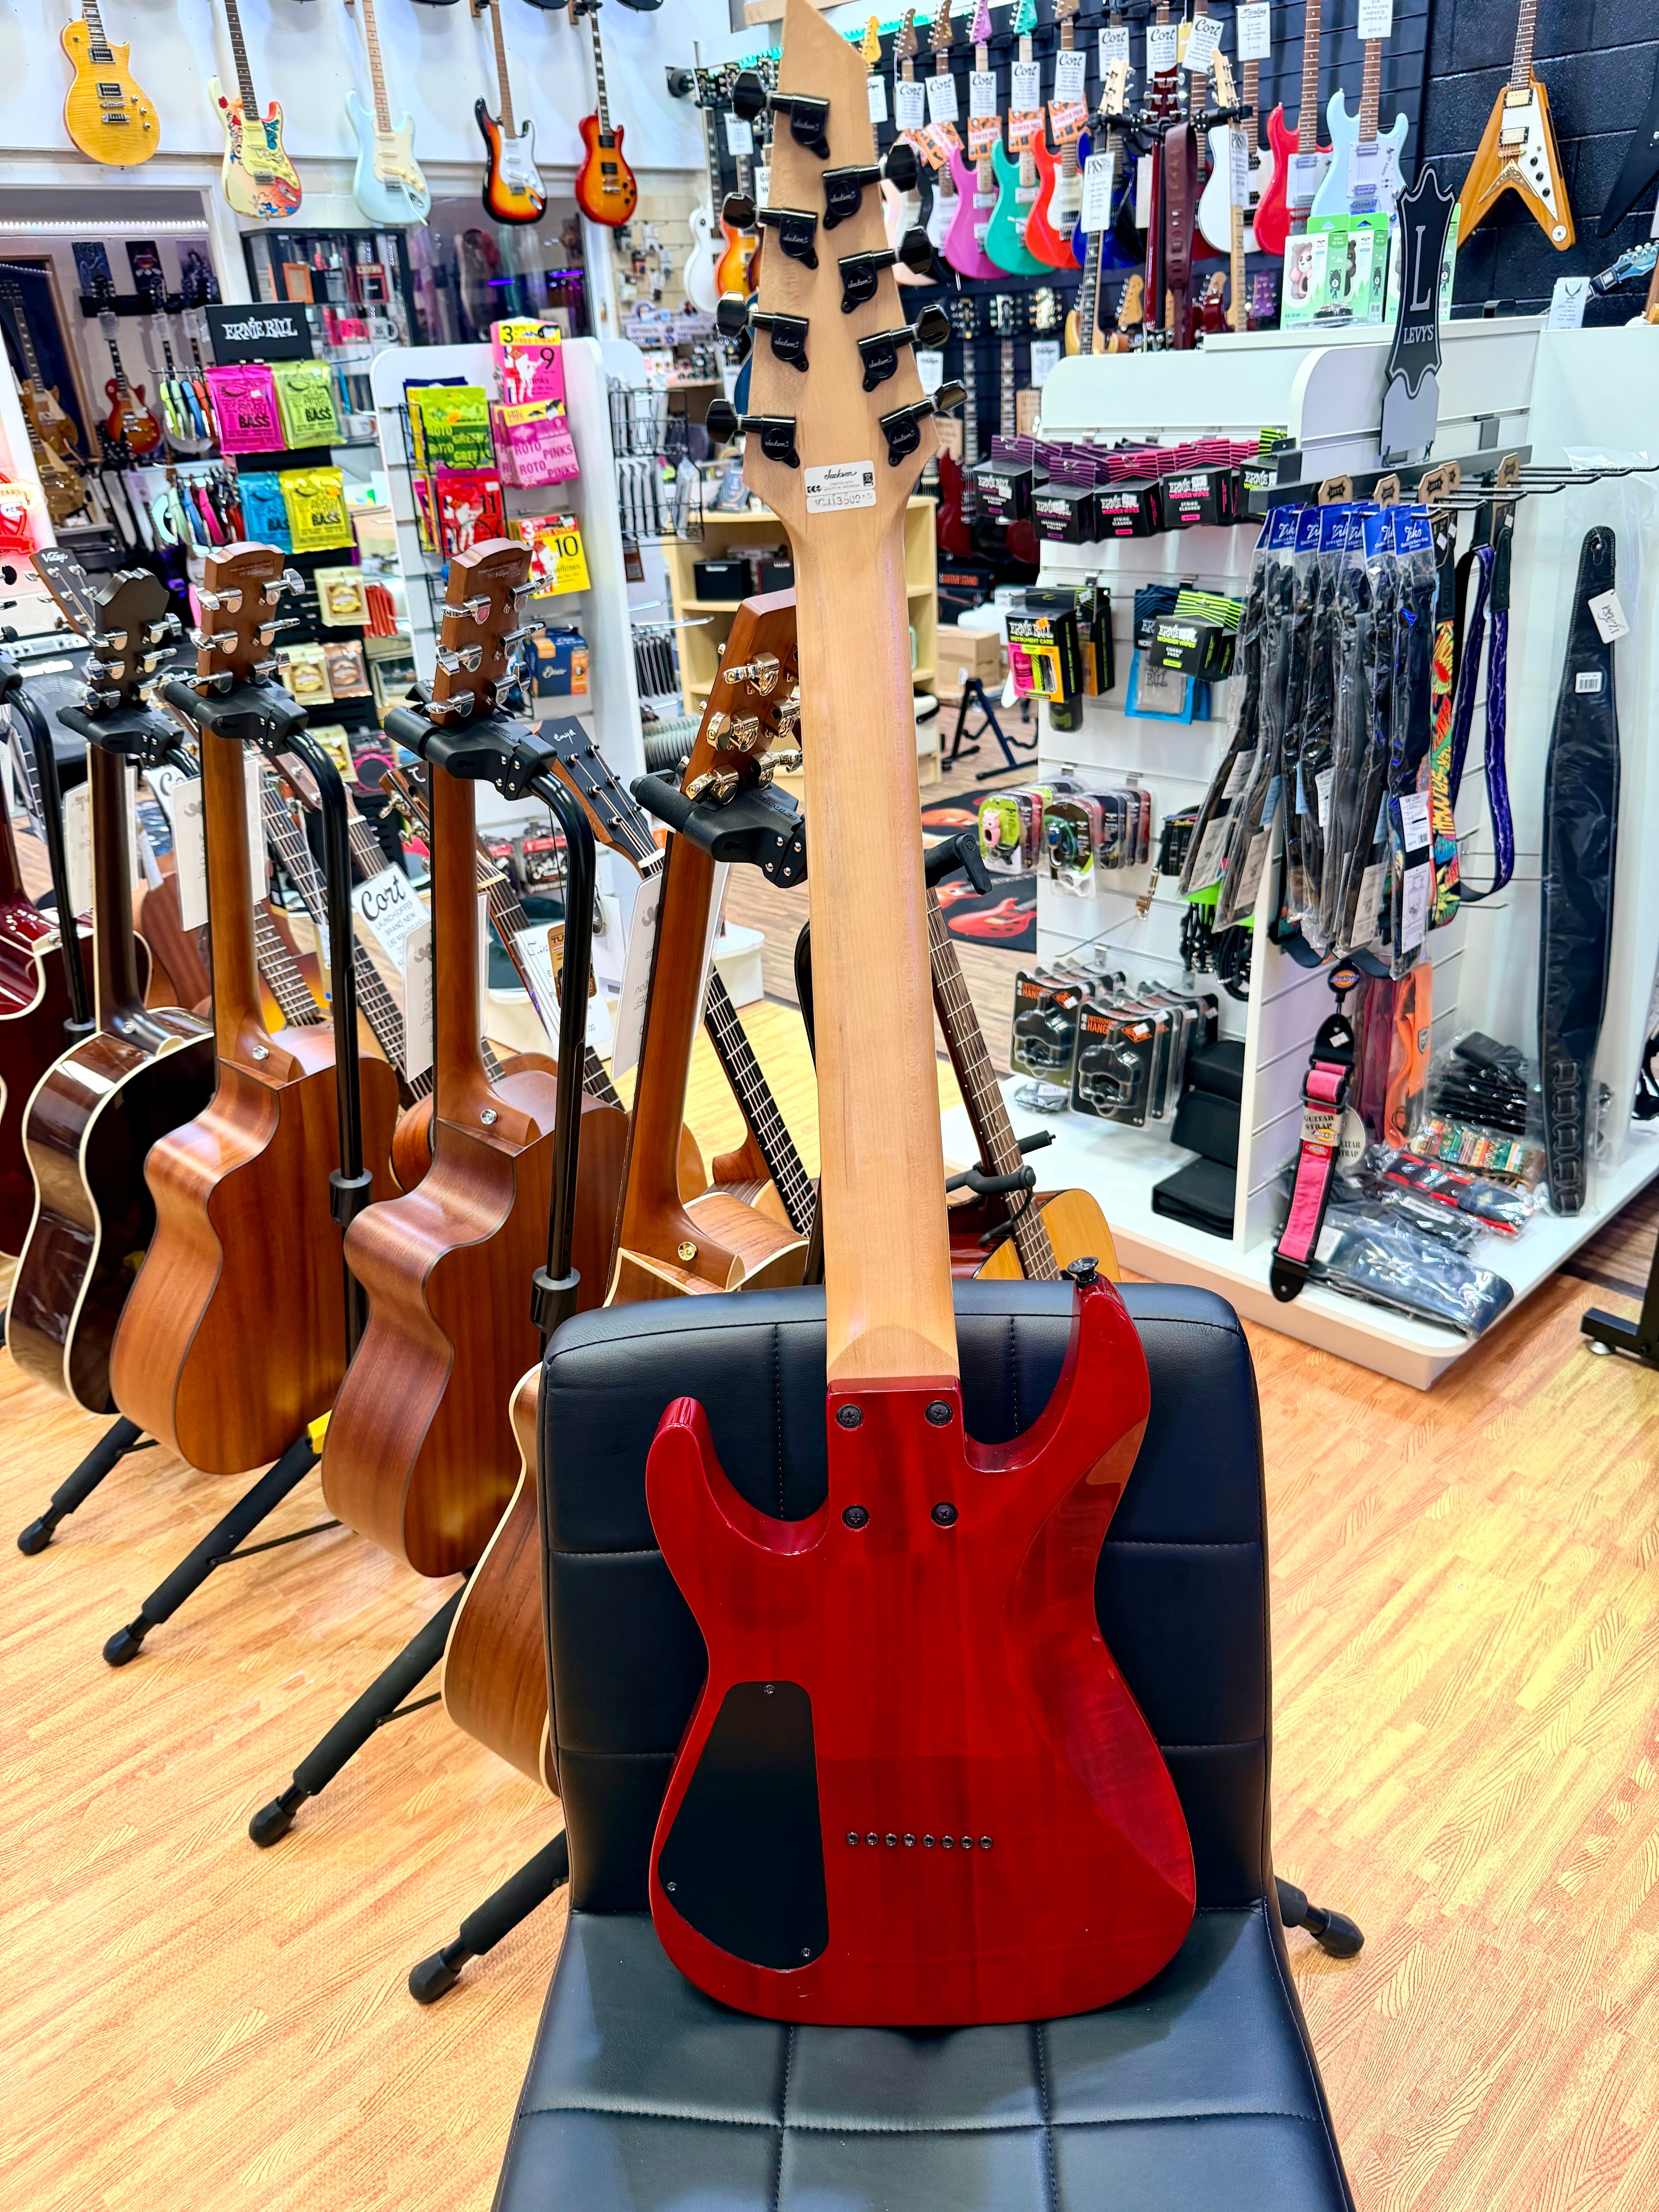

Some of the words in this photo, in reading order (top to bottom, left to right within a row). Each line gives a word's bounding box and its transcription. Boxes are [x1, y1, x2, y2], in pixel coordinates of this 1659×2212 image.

[1151, 28, 1175, 42] Cort
[1195, 19, 1221, 36] Cort
[1102, 29, 1126, 44] Cort
[1059, 53, 1083, 66] Cort
[1014, 64, 1037, 76] Cort
[930, 79, 952, 91] Cort
[972, 73, 994, 86] Cort
[900, 84, 922, 96] Cort
[831, 192, 855, 203] Jackson
[783, 234, 808, 244] Jackson
[1410, 225, 1431, 311] L
[848, 277, 872, 289] Jackson
[221, 317, 264, 340] ERNIE
[264, 318, 298, 338] BALL
[502, 325, 513, 343] 3
[1403, 324, 1434, 345] LEVY'S
[775, 338, 799, 348] Jackson
[540, 347, 554, 369] 9
[869, 357, 893, 368] Jackson
[238, 414, 270, 428] BASS
[305, 408, 332, 421] BASS
[892, 431, 915, 444] Jackson
[515, 441, 541, 456] ROTO
[543, 444, 574, 459] PINKS
[519, 461, 546, 476] ROTO
[547, 464, 579, 478] PINKS
[824, 457, 857, 479] Jackson
[1244, 470, 1269, 484] ERNIE
[1168, 477, 1191, 493] ERNIE
[480, 493, 496, 514] 11
[1100, 494, 1122, 509] ERNIE
[311, 512, 340, 526] BASS
[521, 521, 535, 539] 3
[1278, 519, 1295, 539] Tik
[555, 536, 578, 558] 10
[1008, 620, 1032, 637] ERNIE
[1159, 623, 1180, 638] ERNIE
[1010, 635, 1039, 644] INSTRUMENT
[1157, 635, 1179, 645] WONDER
[1179, 640, 1196, 649] WIPES
[554, 728, 576, 744] enya
[361, 874, 406, 921] Cort
[375, 912, 396, 930] LAUNCH
[397, 900, 414, 917] OFFER
[385, 919, 404, 936] BRAND
[403, 911, 417, 924] NEW
[1340, 1140, 1360, 1148] UITAR
